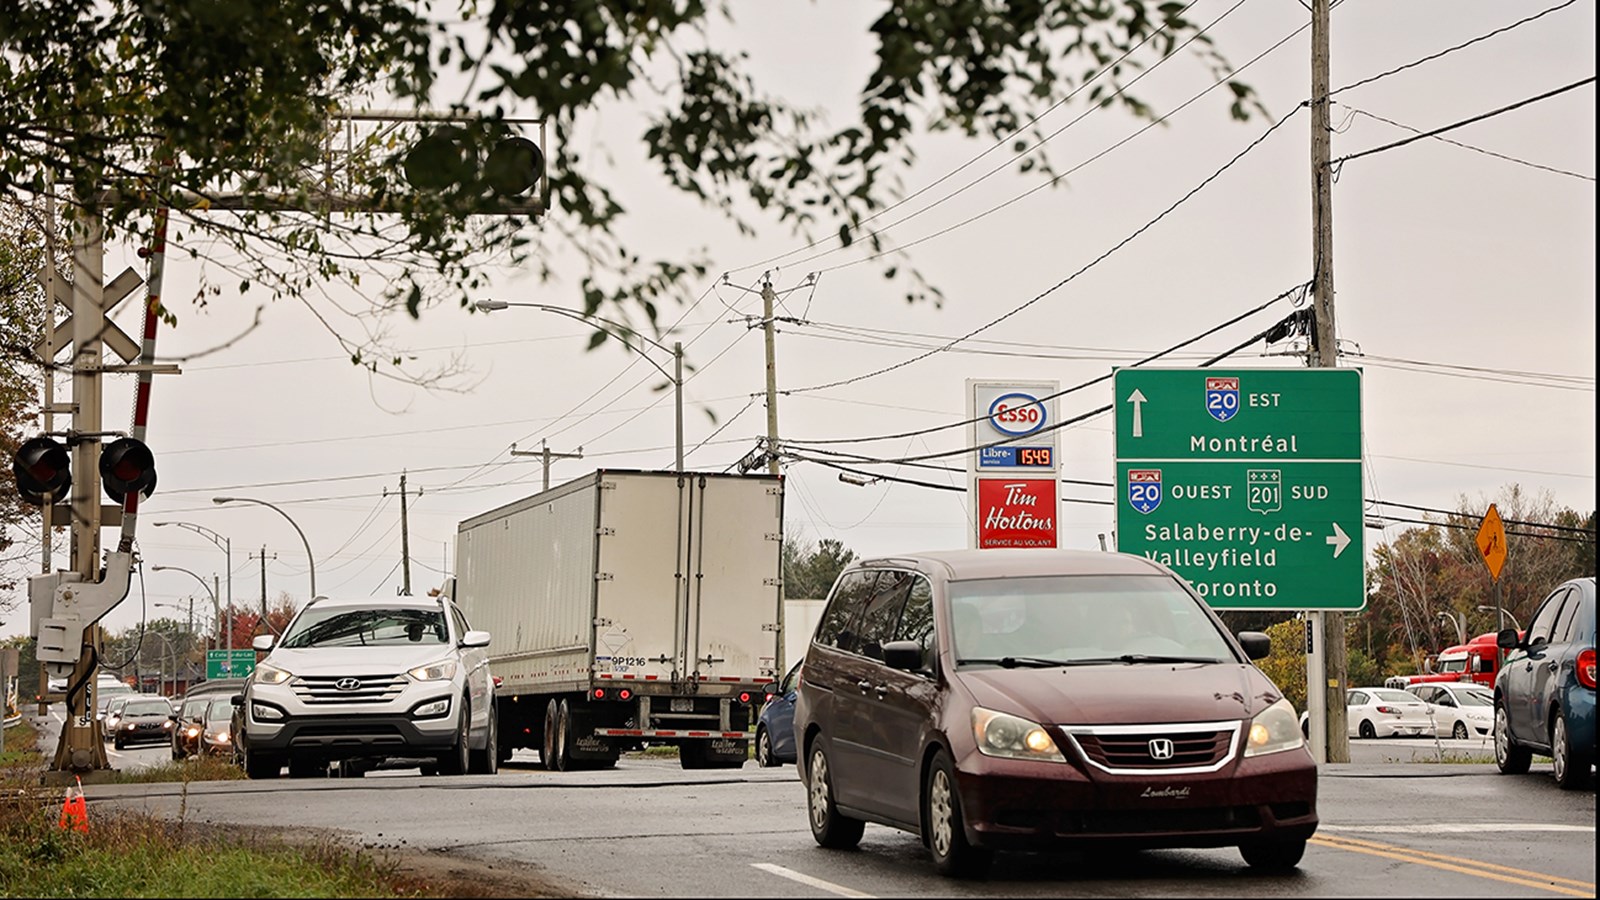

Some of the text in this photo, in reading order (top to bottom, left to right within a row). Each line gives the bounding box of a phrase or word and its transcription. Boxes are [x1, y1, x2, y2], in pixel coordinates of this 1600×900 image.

[1208, 393, 1281, 409] 20 EST
[997, 404, 1038, 423] Esso
[1190, 435, 1298, 452] Montréal
[982, 448, 1011, 457] Libre-
[1004, 483, 1037, 506] Tim
[1131, 485, 1329, 503] 20 OUEST 201 SUD
[984, 506, 1052, 530] Hortons
[1145, 523, 1313, 545] Salaberry-de-
[1145, 549, 1277, 571] Valleyfield
[1186, 580, 1278, 597] oronto
[612, 656, 646, 667] 9P1216
[1140, 786, 1191, 798] Lombardi
